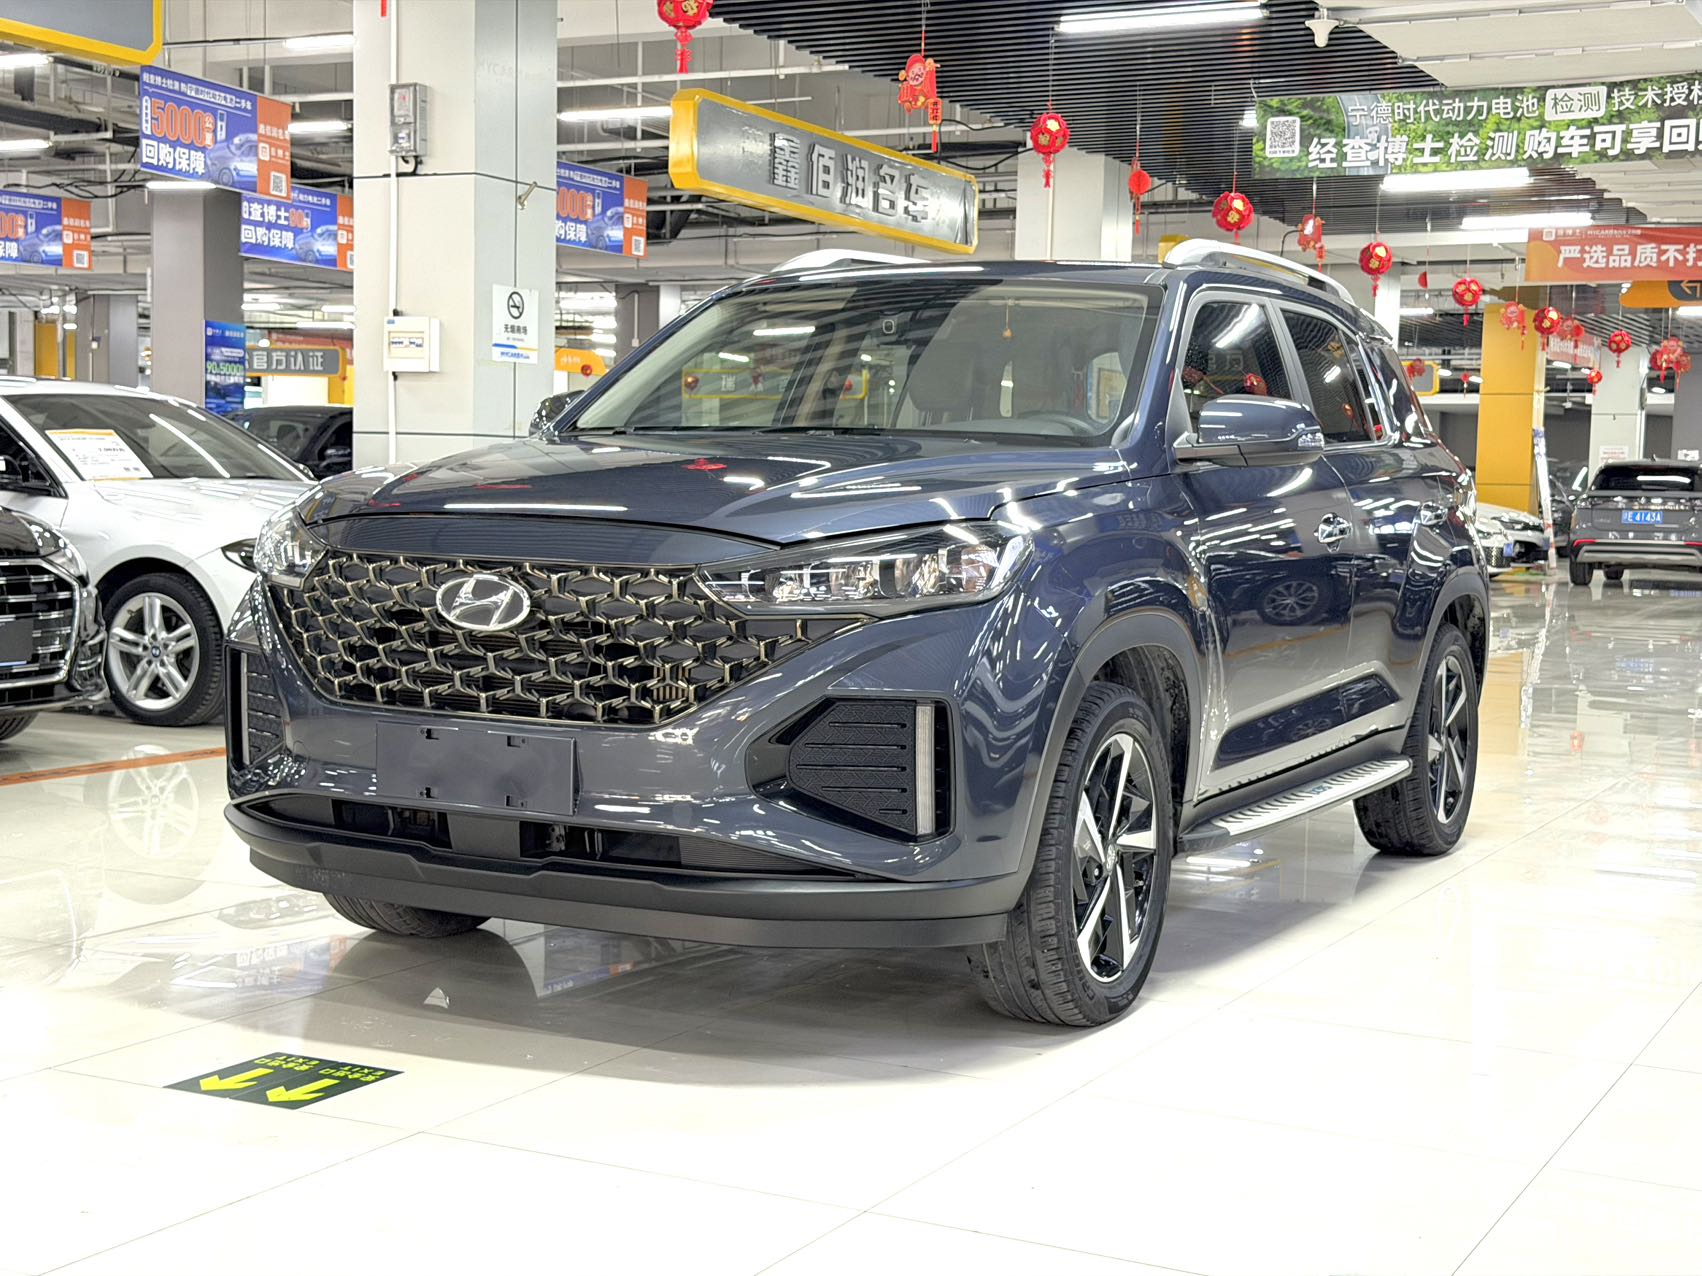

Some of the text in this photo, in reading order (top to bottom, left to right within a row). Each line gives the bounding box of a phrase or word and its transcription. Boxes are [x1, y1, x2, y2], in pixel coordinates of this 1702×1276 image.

[1348, 94, 1538, 125] 宁德时代动力电池
[1551, 91, 1601, 115] 检测
[142, 138, 206, 175] 回购保障
[1308, 118, 1702, 168] 经查博士检测购车可享回
[241, 224, 295, 249] 回购保障
[1557, 243, 1702, 268] 严选品质不打
